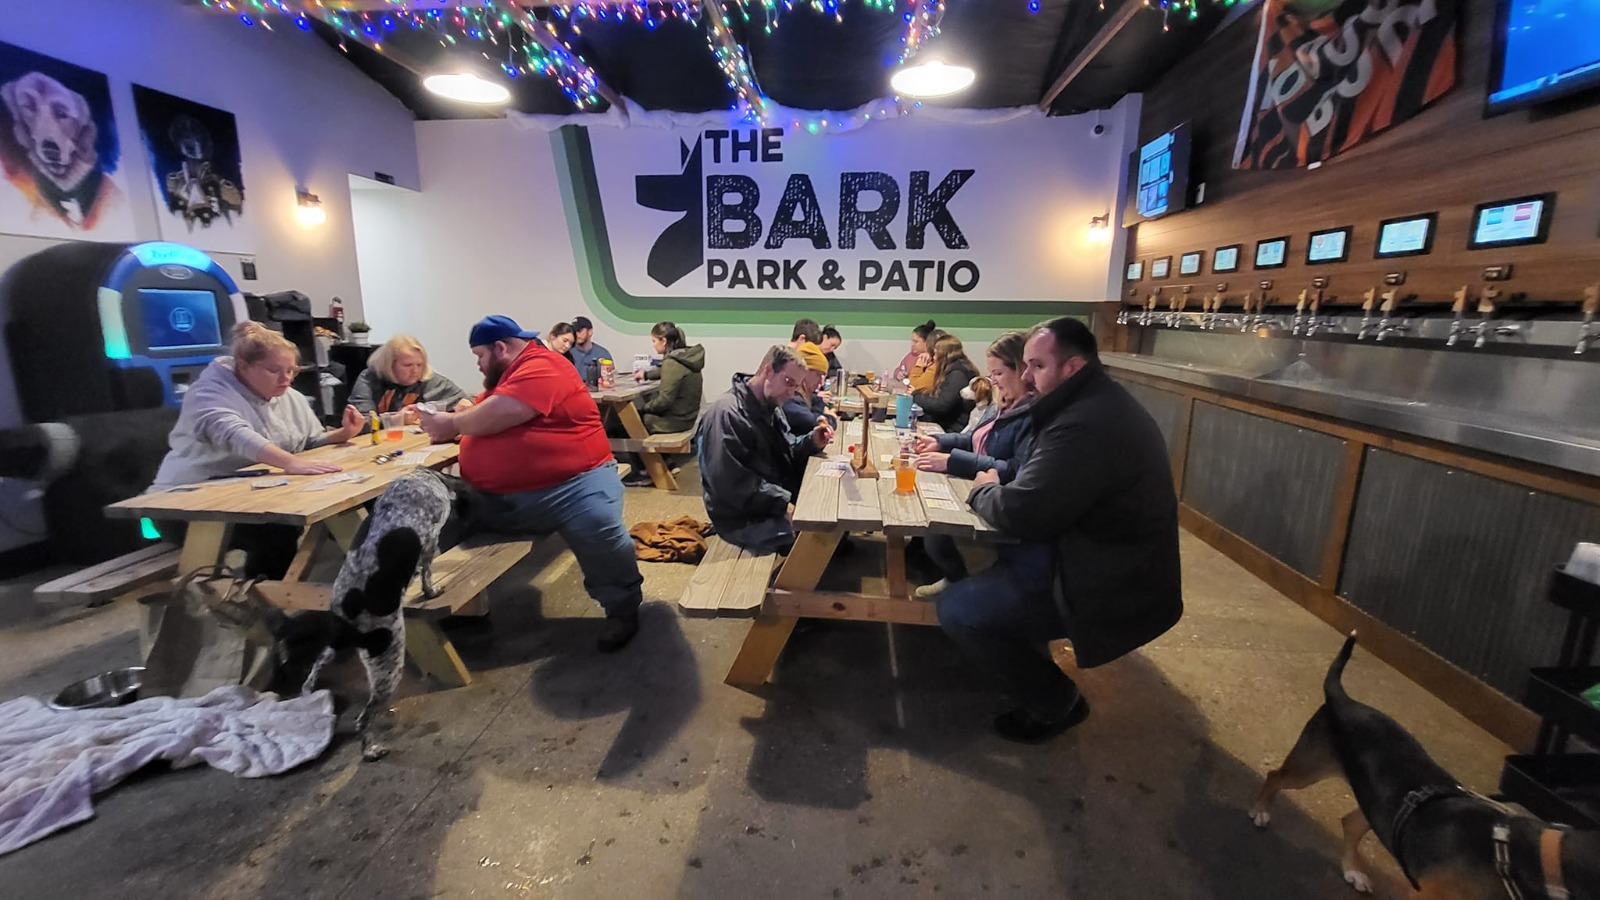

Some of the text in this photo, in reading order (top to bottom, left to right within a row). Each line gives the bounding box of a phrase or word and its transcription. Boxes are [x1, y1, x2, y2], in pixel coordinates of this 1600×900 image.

[705, 128, 784, 163] THE
[706, 169, 975, 250] BARK
[707, 259, 980, 293] PARK & PATIO
